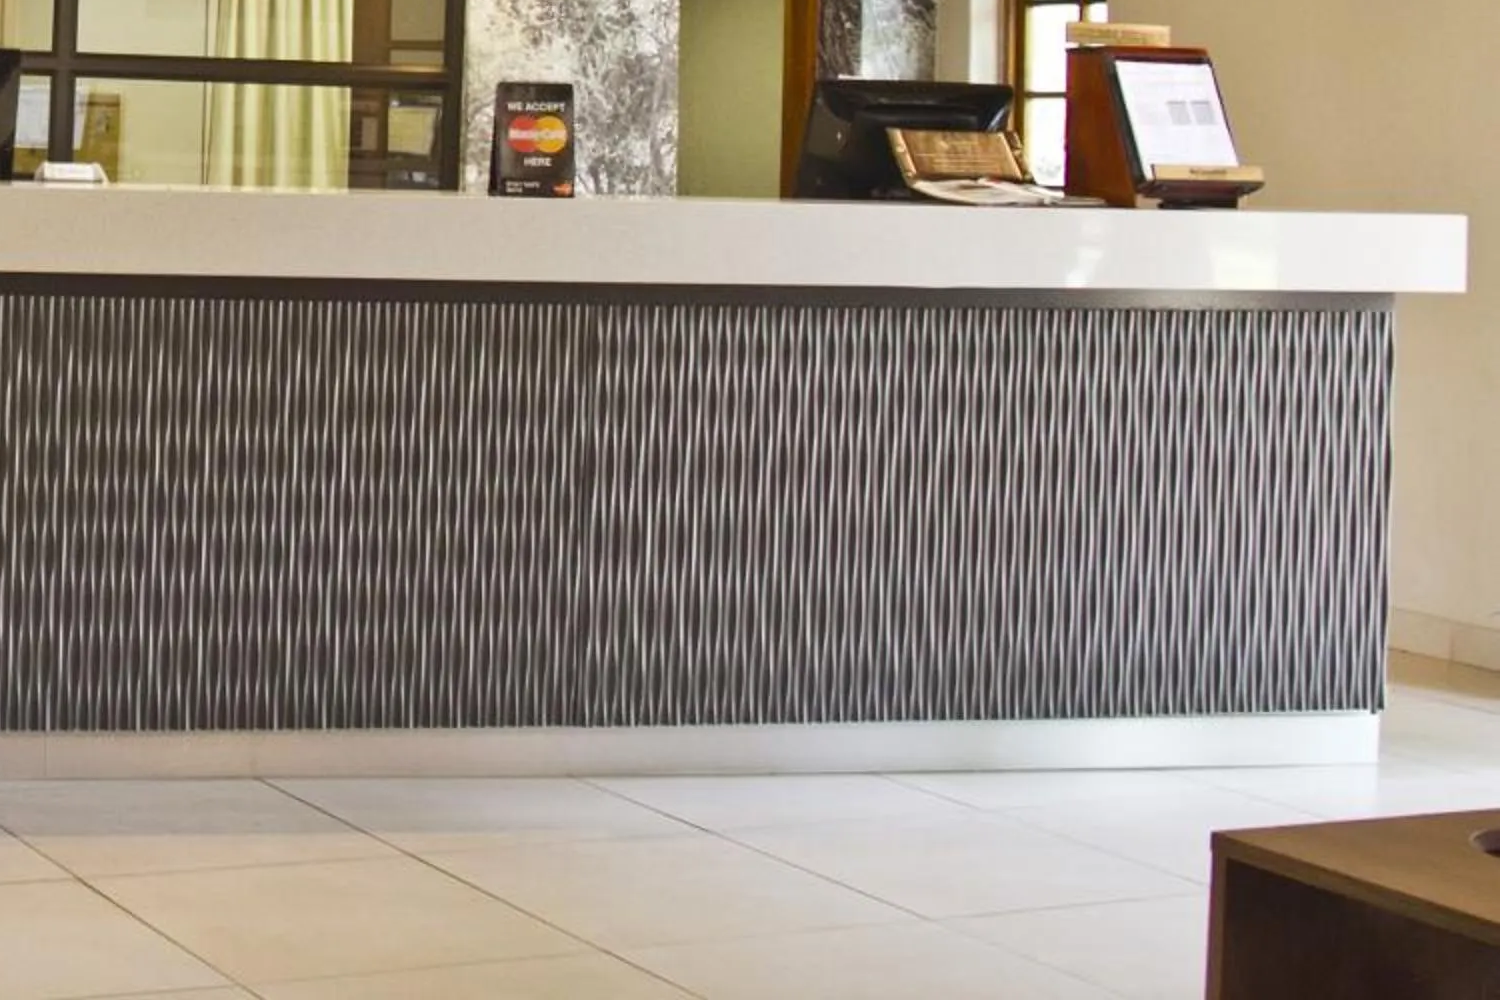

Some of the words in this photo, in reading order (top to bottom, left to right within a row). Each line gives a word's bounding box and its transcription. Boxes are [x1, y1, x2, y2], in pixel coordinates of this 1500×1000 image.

[507, 101, 523, 112] WE
[525, 102, 566, 112] ACCEPT
[523, 156, 553, 167] HERE
